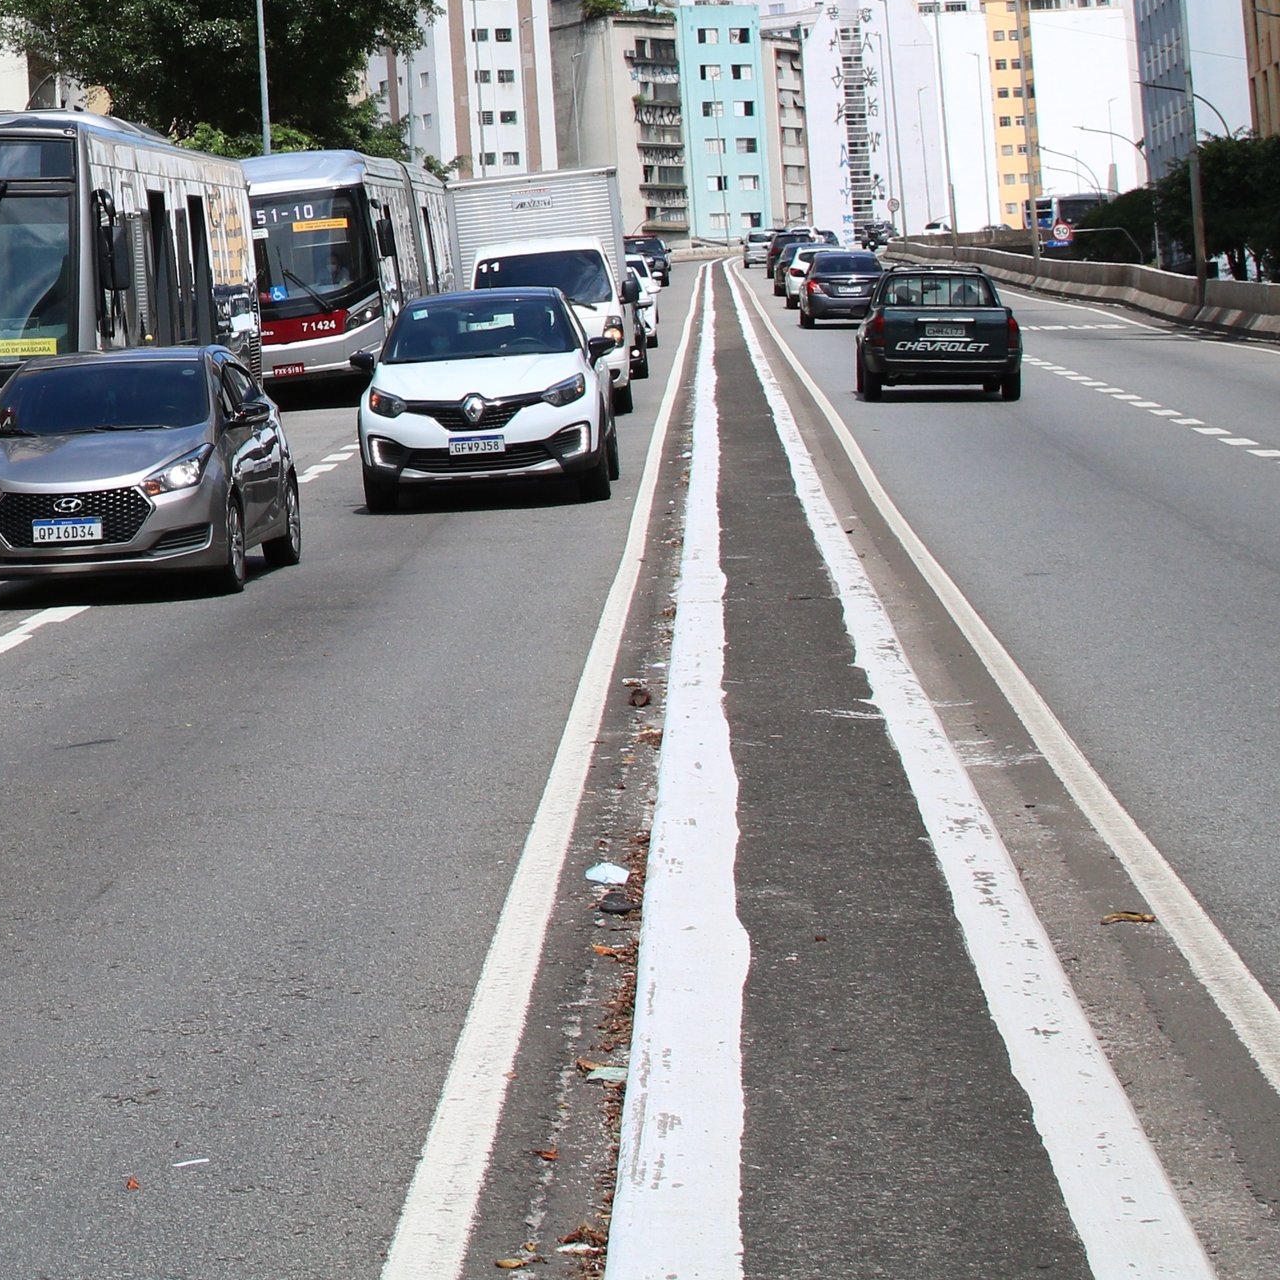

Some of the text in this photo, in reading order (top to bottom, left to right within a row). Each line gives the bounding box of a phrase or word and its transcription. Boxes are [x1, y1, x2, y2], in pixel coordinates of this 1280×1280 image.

[1055, 227, 1069, 236] 50
[301, 320, 337, 332] 7 1424
[895, 341, 989, 353] CHEVROLET
[454, 441, 500, 453] GFW9J58
